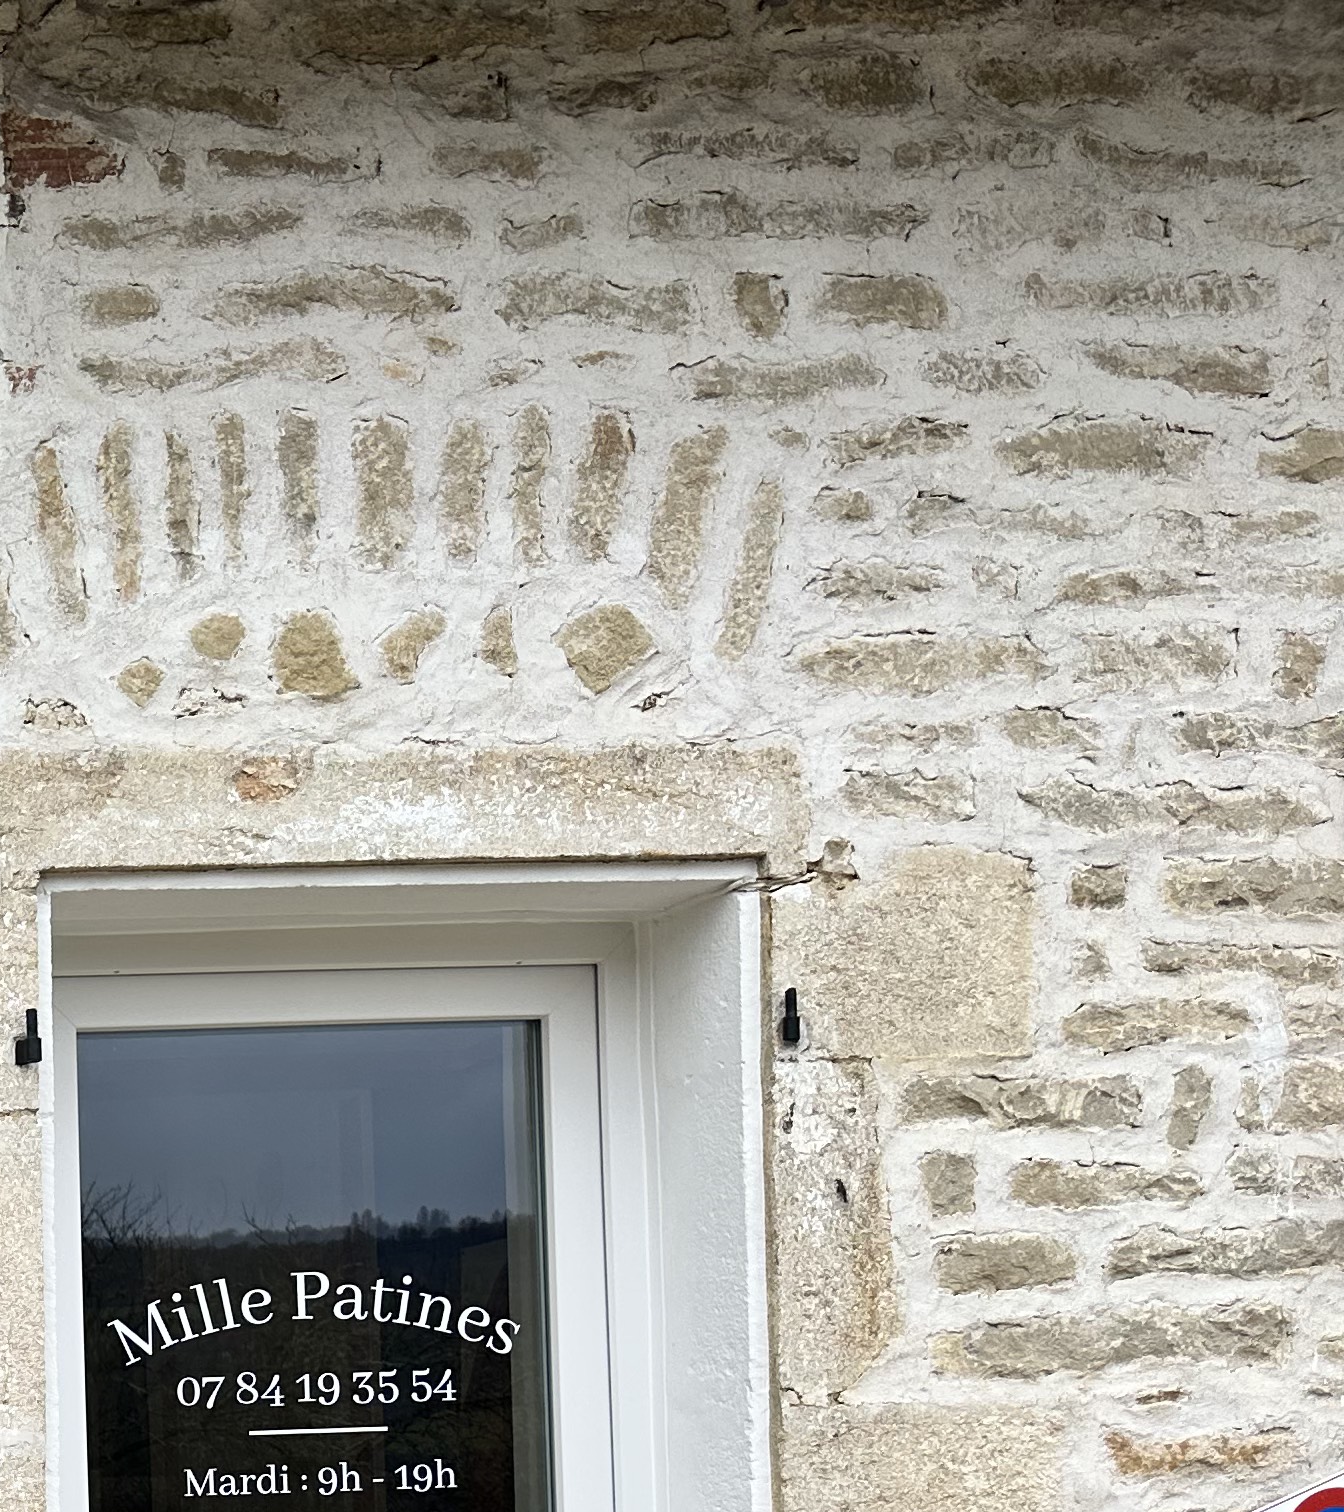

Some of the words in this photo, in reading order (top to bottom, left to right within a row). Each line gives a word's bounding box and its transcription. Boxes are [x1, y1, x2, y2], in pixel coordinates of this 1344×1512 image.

[107, 1279, 274, 1367] Mille
[290, 1271, 521, 1355] Patines
[176, 1376, 226, 1410] 07
[236, 1371, 285, 1407] 84
[295, 1372, 341, 1406] 19
[352, 1368, 400, 1405] 35
[410, 1367, 457, 1403] 54
[183, 1463, 292, 1497] Mardi
[317, 1461, 364, 1496] 9h
[394, 1458, 458, 1493] 19h
